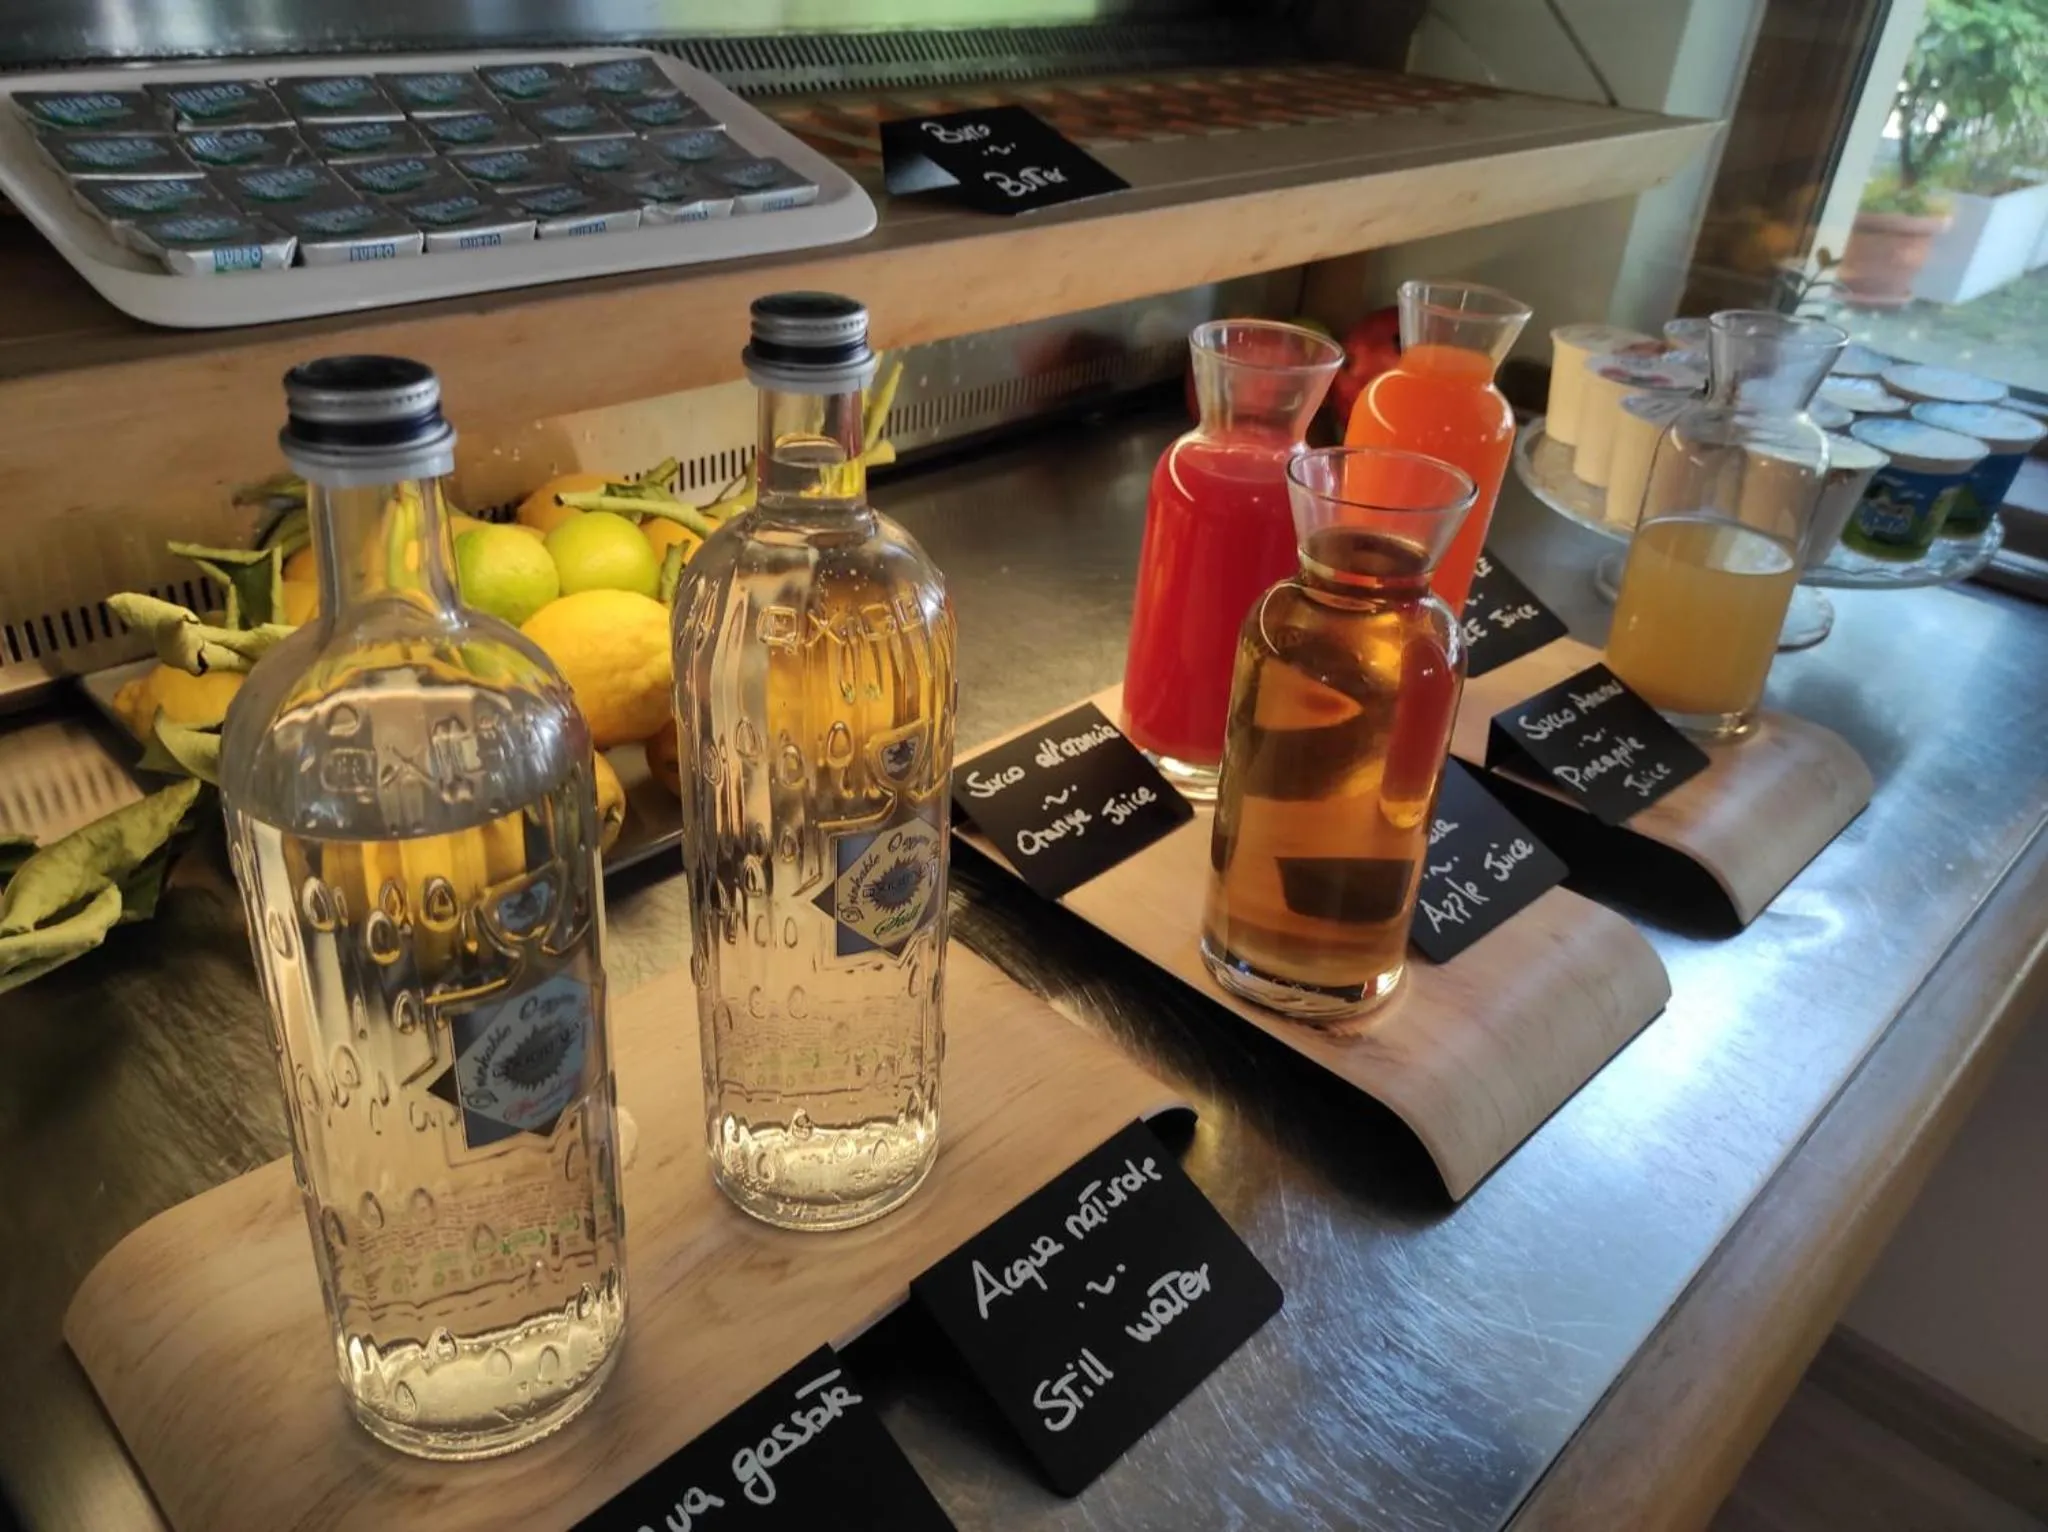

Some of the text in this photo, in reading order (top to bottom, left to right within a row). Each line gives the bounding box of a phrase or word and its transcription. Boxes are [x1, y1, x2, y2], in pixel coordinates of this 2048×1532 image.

[214, 245, 262, 267] BURRO
[1552, 736, 1645, 792] Pineapple
[1622, 762, 1671, 797] Juice
[1017, 786, 1157, 855] Orange Juice
[1419, 838, 1534, 934] Apple Juice
[972, 1235, 1064, 1320] Acqua
[1125, 1263, 1211, 1342] water
